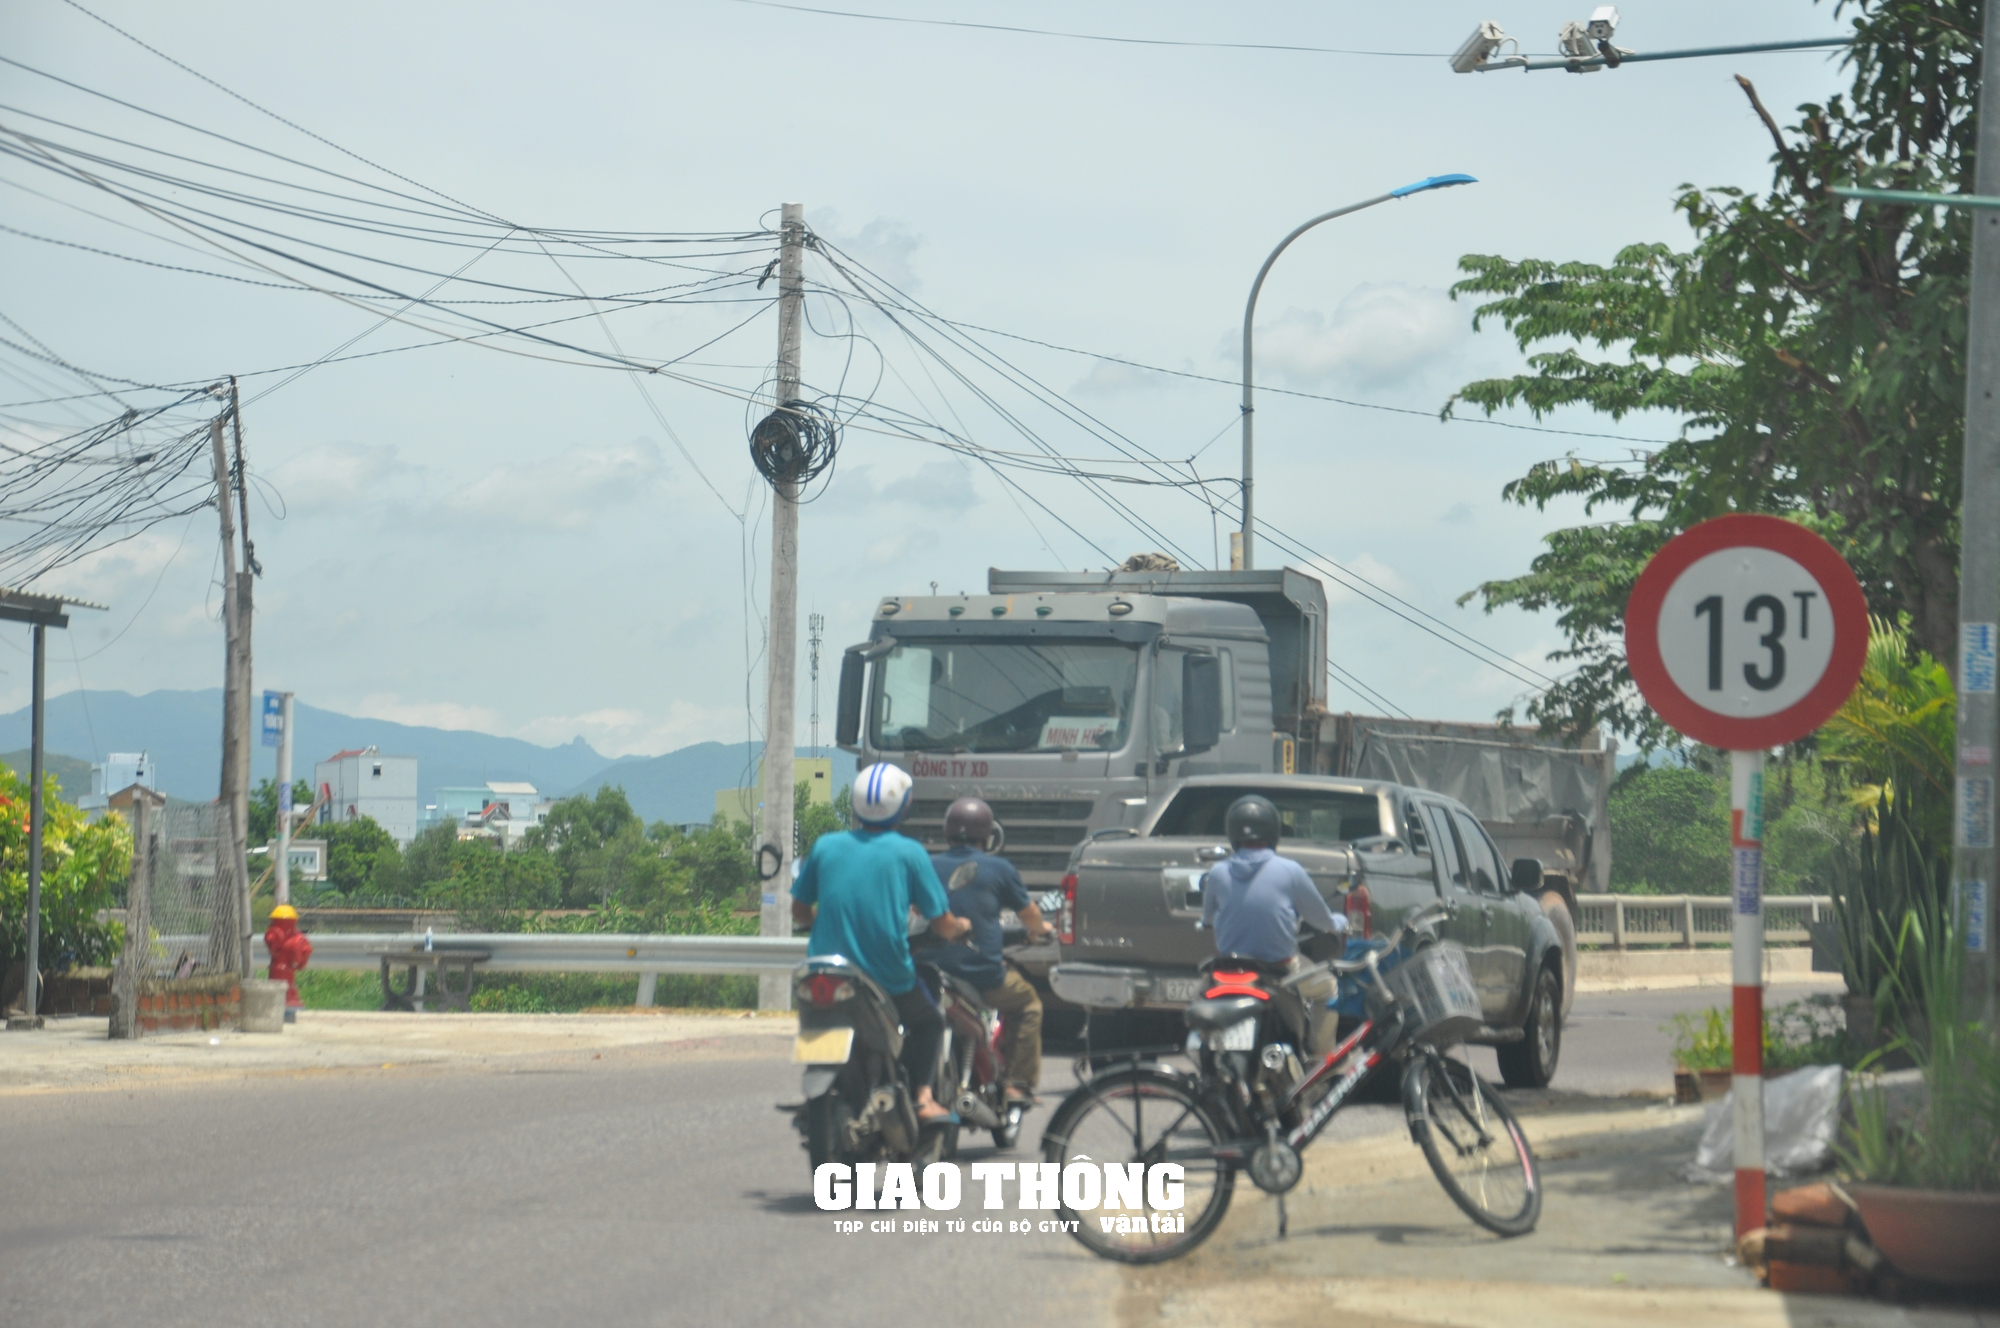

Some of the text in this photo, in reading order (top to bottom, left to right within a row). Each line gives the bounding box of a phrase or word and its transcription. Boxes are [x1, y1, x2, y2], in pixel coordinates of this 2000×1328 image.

[1046, 727, 1080, 745] MINH
[912, 757, 989, 778] CÔNG TY XD
